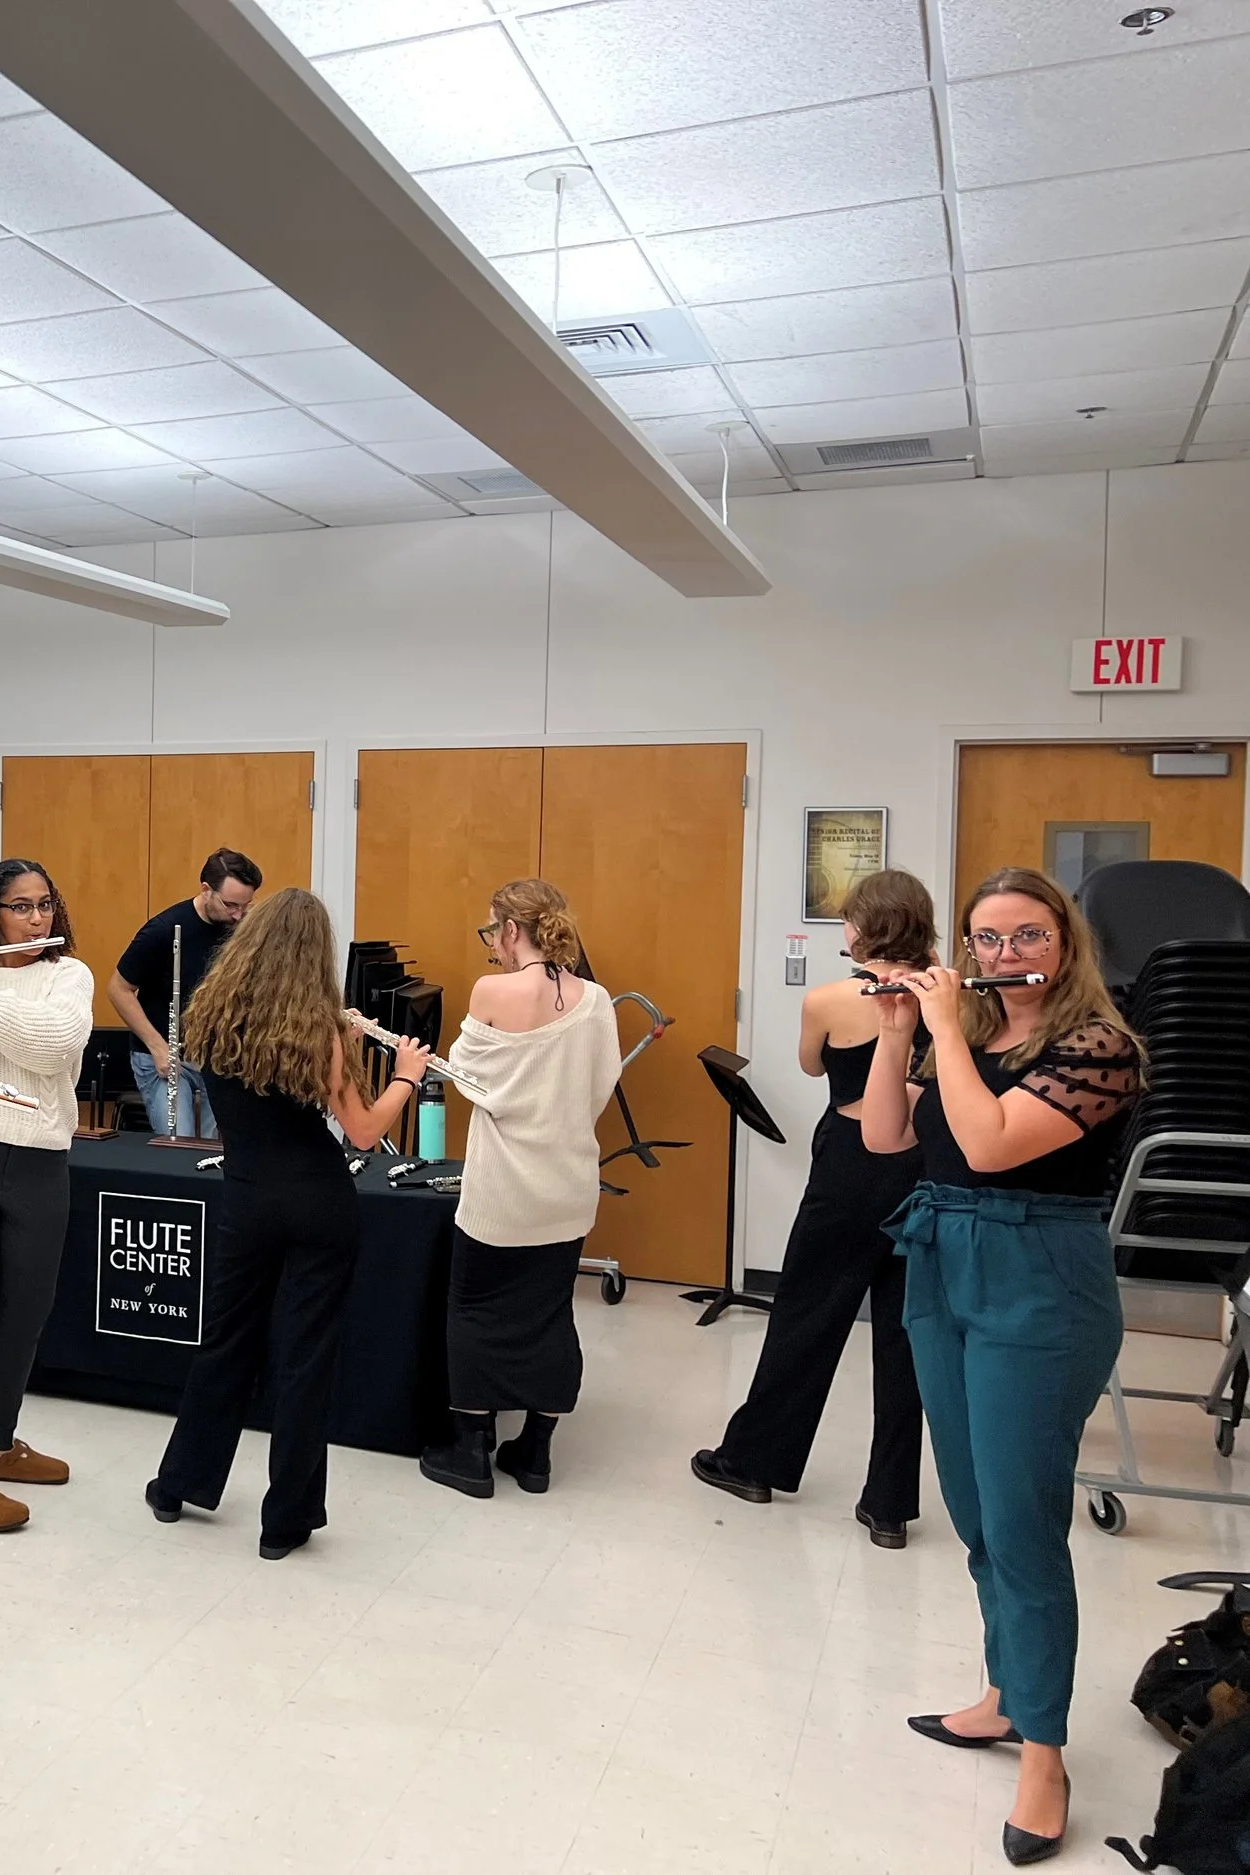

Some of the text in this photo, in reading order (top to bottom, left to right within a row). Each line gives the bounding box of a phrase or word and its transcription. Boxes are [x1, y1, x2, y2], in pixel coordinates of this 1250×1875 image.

[1093, 638, 1166, 684] EXIT
[110, 1218, 192, 1254] FLUTE
[110, 1249, 191, 1277] CENTER
[144, 1282, 156, 1296] of
[110, 1298, 188, 1318] NEW YORK
